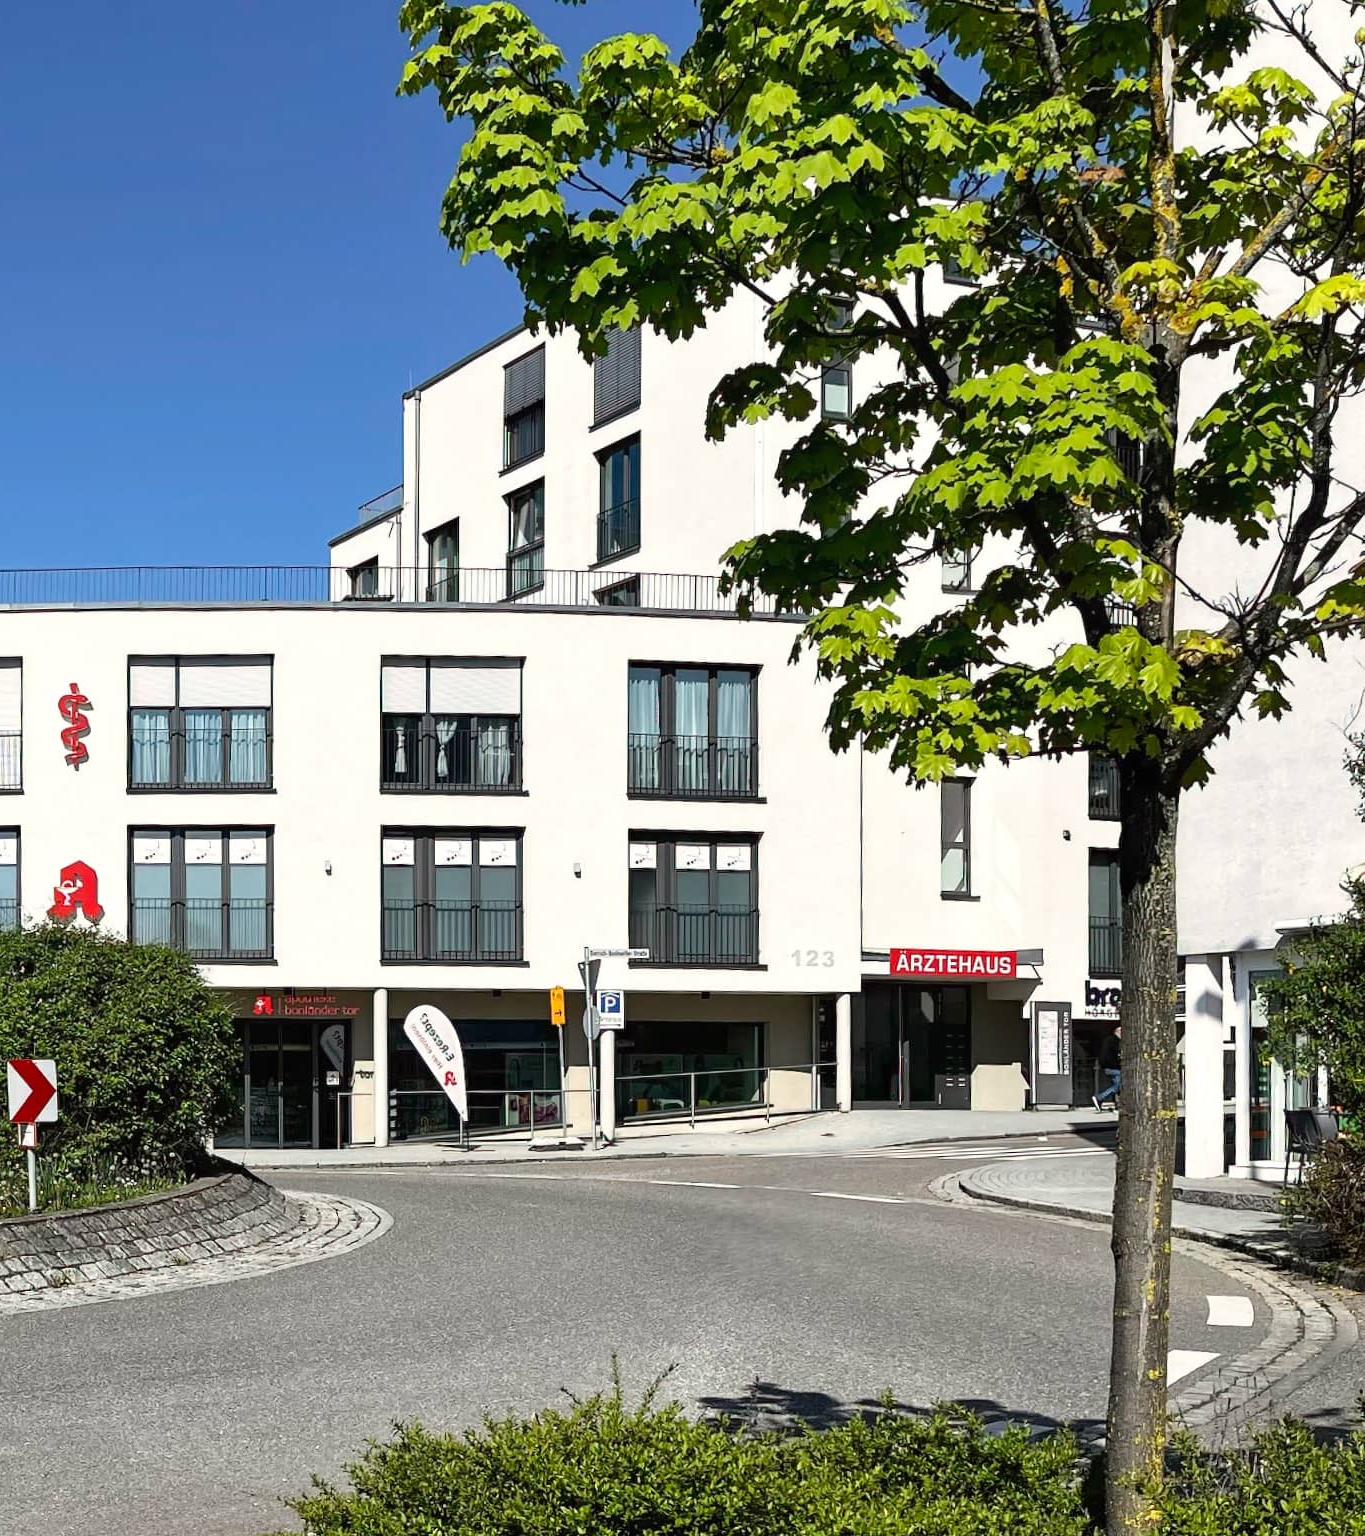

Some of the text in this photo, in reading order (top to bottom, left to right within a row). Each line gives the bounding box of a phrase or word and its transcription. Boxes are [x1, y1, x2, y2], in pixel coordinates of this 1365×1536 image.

[791, 949, 835, 967] 123
[896, 950, 1012, 974] ÄRZTEHAUS
[342, 1006, 361, 1015] tor
